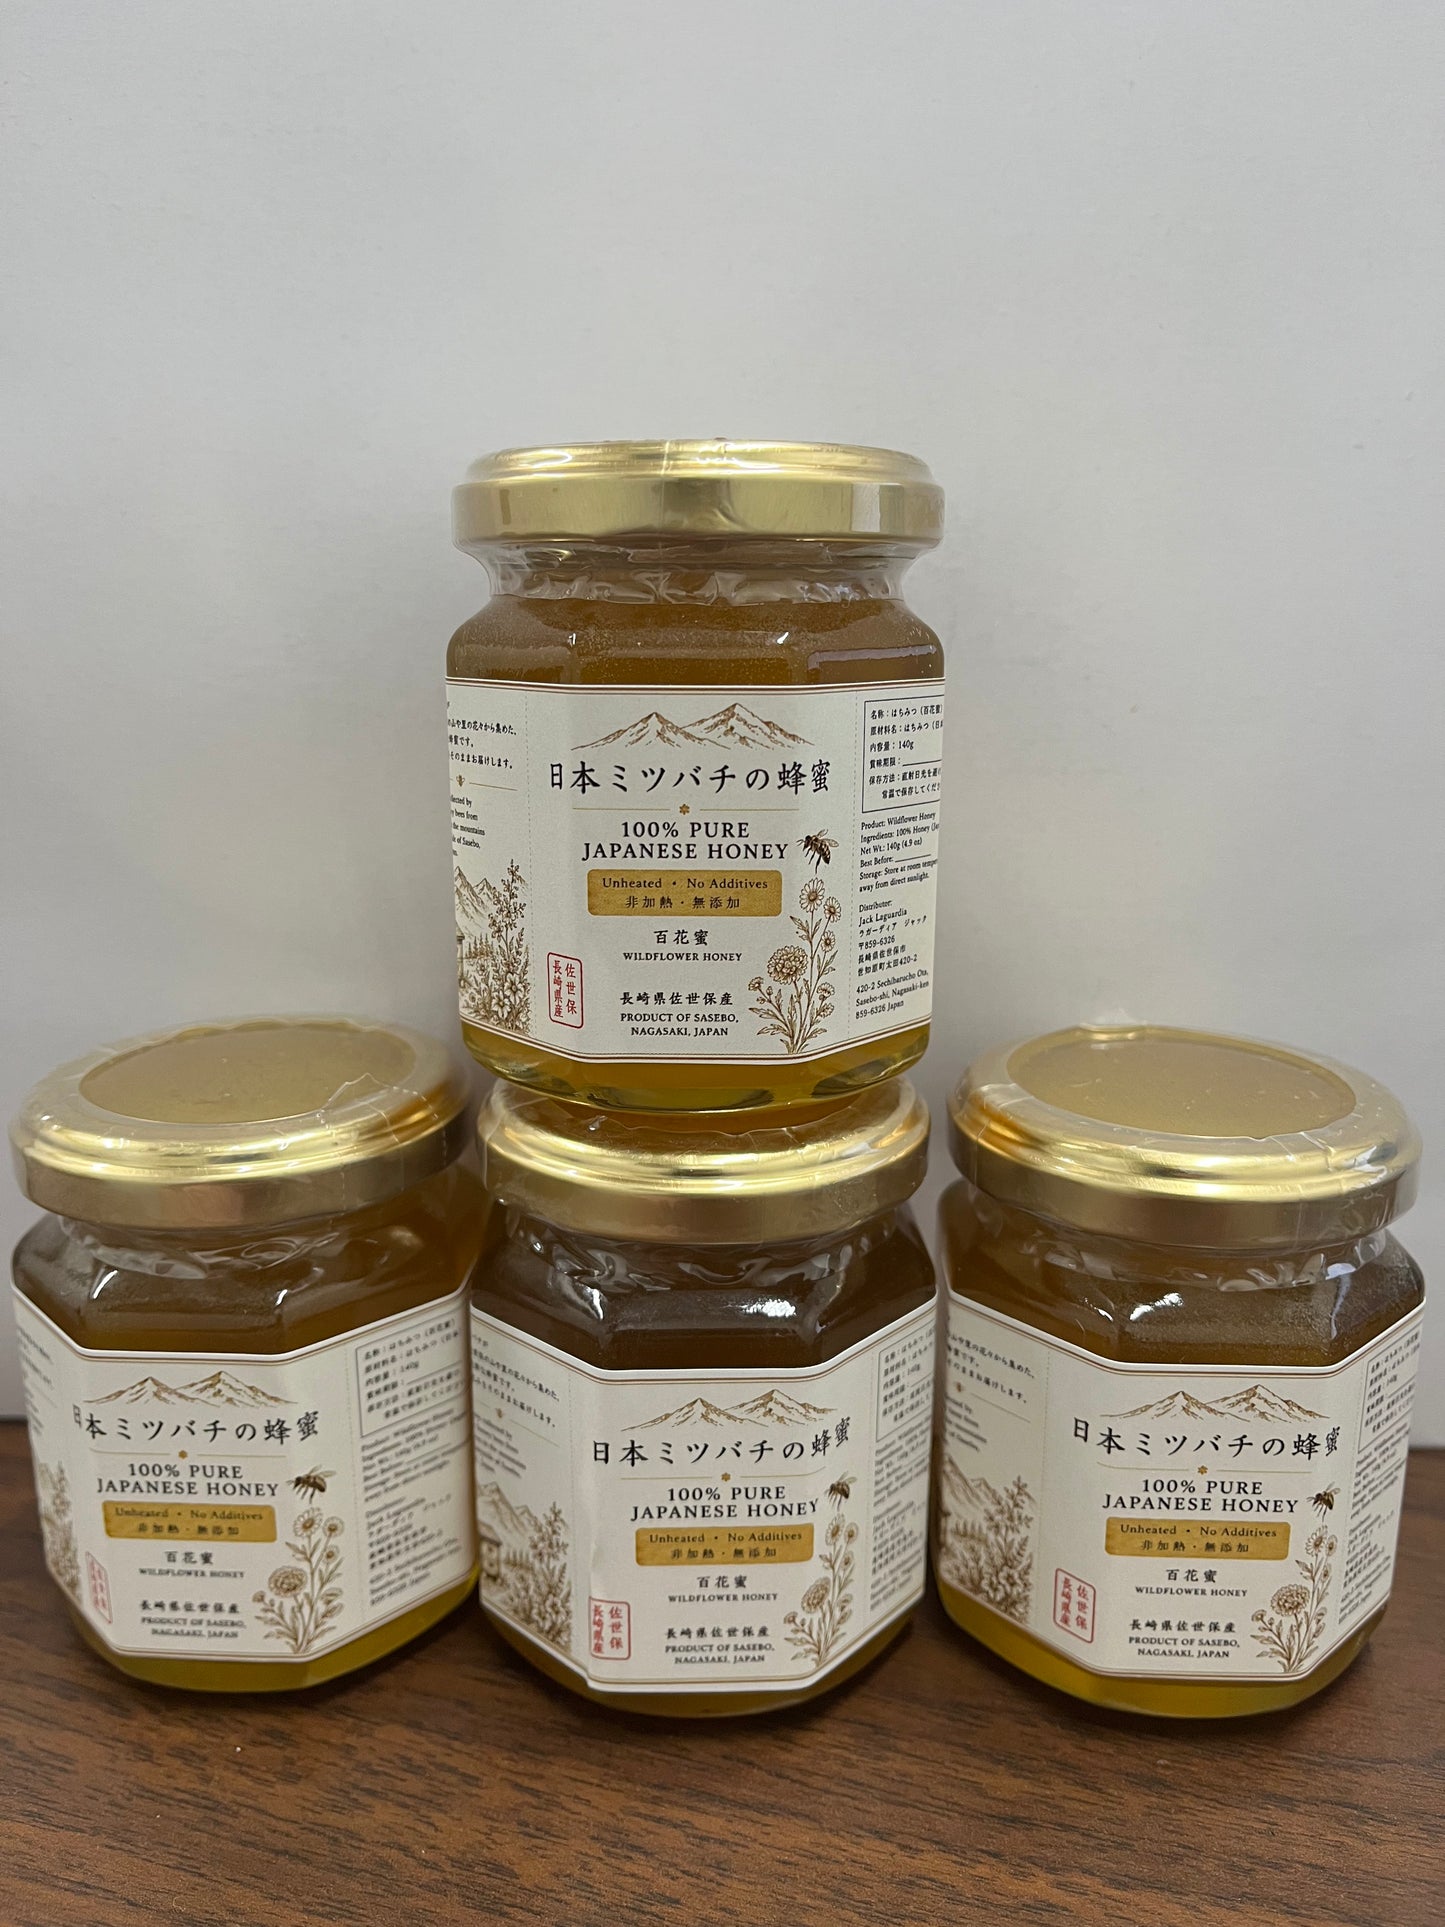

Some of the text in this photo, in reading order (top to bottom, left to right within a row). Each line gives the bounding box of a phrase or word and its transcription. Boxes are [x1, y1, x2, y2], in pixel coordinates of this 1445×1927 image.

[550, 759, 831, 795] 日本ミツバチの蜂蜜
[887, 815, 918, 826] Wildflower
[919, 812, 936, 821] Honey
[621, 822, 750, 838] 100% PURE
[896, 827, 911, 837] 100%
[913, 824, 930, 834] Honey
[582, 843, 789, 861] JAPANESE HONEY
[860, 847, 871, 856] Net
[887, 841, 901, 851] 140g
[860, 859, 872, 868] Best
[884, 867, 899, 876] Store
[907, 863, 921, 871] room
[602, 878, 768, 889] Unheated No Additives
[859, 884, 874, 892] away
[875, 880, 889, 889] from
[890, 877, 906, 886] direct
[625, 896, 740, 910] 非加熱・無添加
[858, 908, 908, 927] Jack Laguardia
[653, 930, 709, 946] 百花蜜
[623, 952, 743, 962] WILDFLOWER HONEY
[553, 959, 564, 1019] 長崎県産
[565, 963, 577, 1015] 佐世保
[856, 982, 875, 994] 420-2
[892, 981, 929, 997] Nagasaki-ken
[620, 992, 734, 1006] 長崎県佐世保産
[855, 1000, 904, 1019] 859-6326 Japan
[620, 1013, 739, 1024] PRODUCT OF SASEBO,
[631, 1027, 729, 1038] NAGASAKI, JAPAN
[72, 1404, 320, 1445] 日本ミツバチの蜂蜜
[593, 1416, 851, 1467] 日本ミツバチの蜂蜜
[1073, 1417, 1341, 1460] 日本ミツバチの蜂蜜
[129, 1464, 244, 1479] 100% PURE
[97, 1478, 280, 1497] JAPANESE HONEY
[668, 1486, 786, 1501] 100% PURE
[1142, 1479, 1263, 1495] 100% PURE
[630, 1498, 819, 1522] JAPANESE HONEY
[1102, 1494, 1299, 1513] JAPANESE HONEY
[115, 1507, 263, 1521] Unheated No Additives
[649, 1532, 802, 1543] Unheated No Additives
[1120, 1524, 1277, 1538] Unheated No Additives
[697, 1575, 748, 1589] 百花蜜
[1166, 1569, 1218, 1583] 百花蜜
[668, 1592, 779, 1603] WILDFLOWER HONEY
[1135, 1586, 1248, 1597] WILDFLOWER HONEY
[665, 1644, 714, 1654] PRODUCT
[716, 1643, 731, 1653] OF
[1128, 1637, 1178, 1646] PRODUCT
[1181, 1637, 1196, 1647] OF
[733, 1655, 766, 1664] JAPAN
[1197, 1649, 1230, 1658] JAPAN
